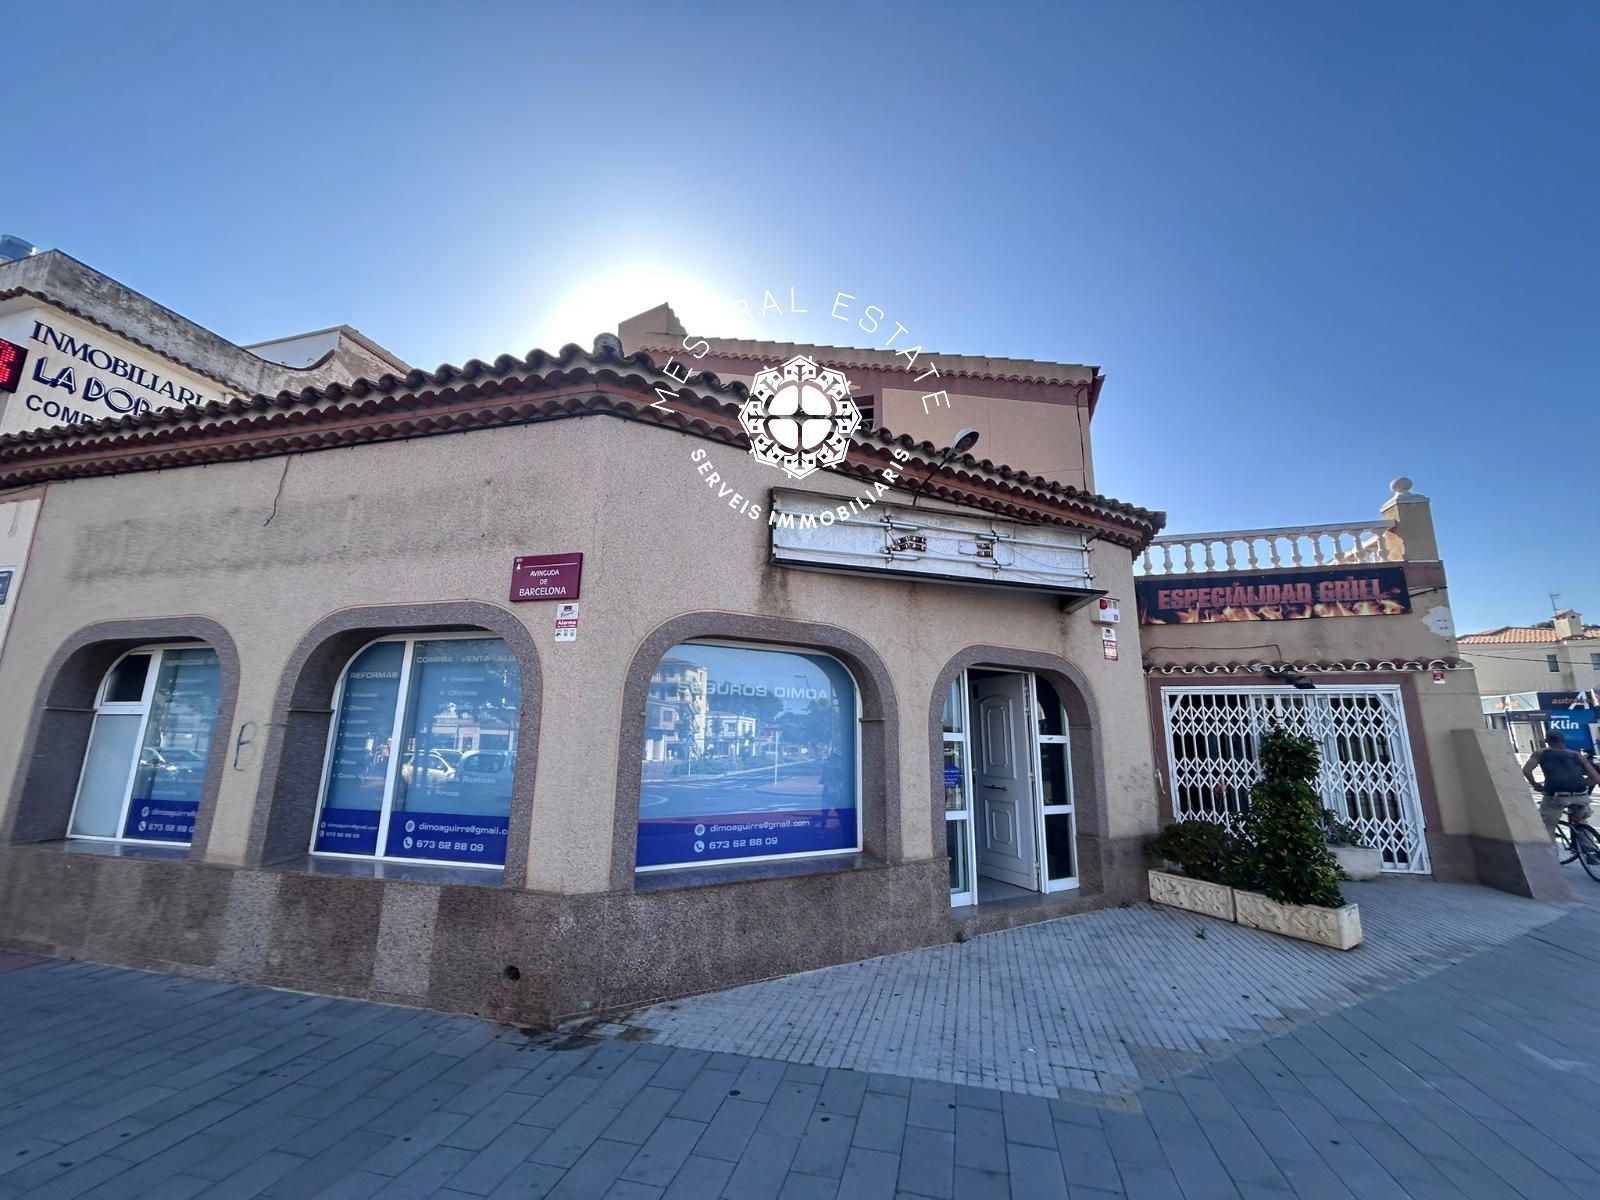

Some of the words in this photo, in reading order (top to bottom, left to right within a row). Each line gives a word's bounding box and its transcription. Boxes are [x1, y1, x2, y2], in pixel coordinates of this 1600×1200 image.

[33, 356, 76, 395] LA
[83, 376, 165, 415] DOR
[530, 569, 560, 577] AVINGUDA
[519, 586, 566, 597] BARCELONA
[1158, 583, 1312, 610] ESPECIALIDAD
[1319, 578, 1381, 602] GRILL
[416, 655, 453, 663] COMPRA
[350, 671, 398, 679] REFORMAS
[1550, 719, 1579, 730] Klin
[710, 819, 810, 833] dimoaguirre@gmail.com
[416, 839, 436, 849] 673
[438, 841, 451, 850] 62
[454, 842, 468, 851] 88
[470, 843, 485, 852] 09
[709, 840, 730, 850] 673
[732, 840, 747, 848] 62
[749, 838, 763, 847] 88
[765, 837, 778, 845] 09
